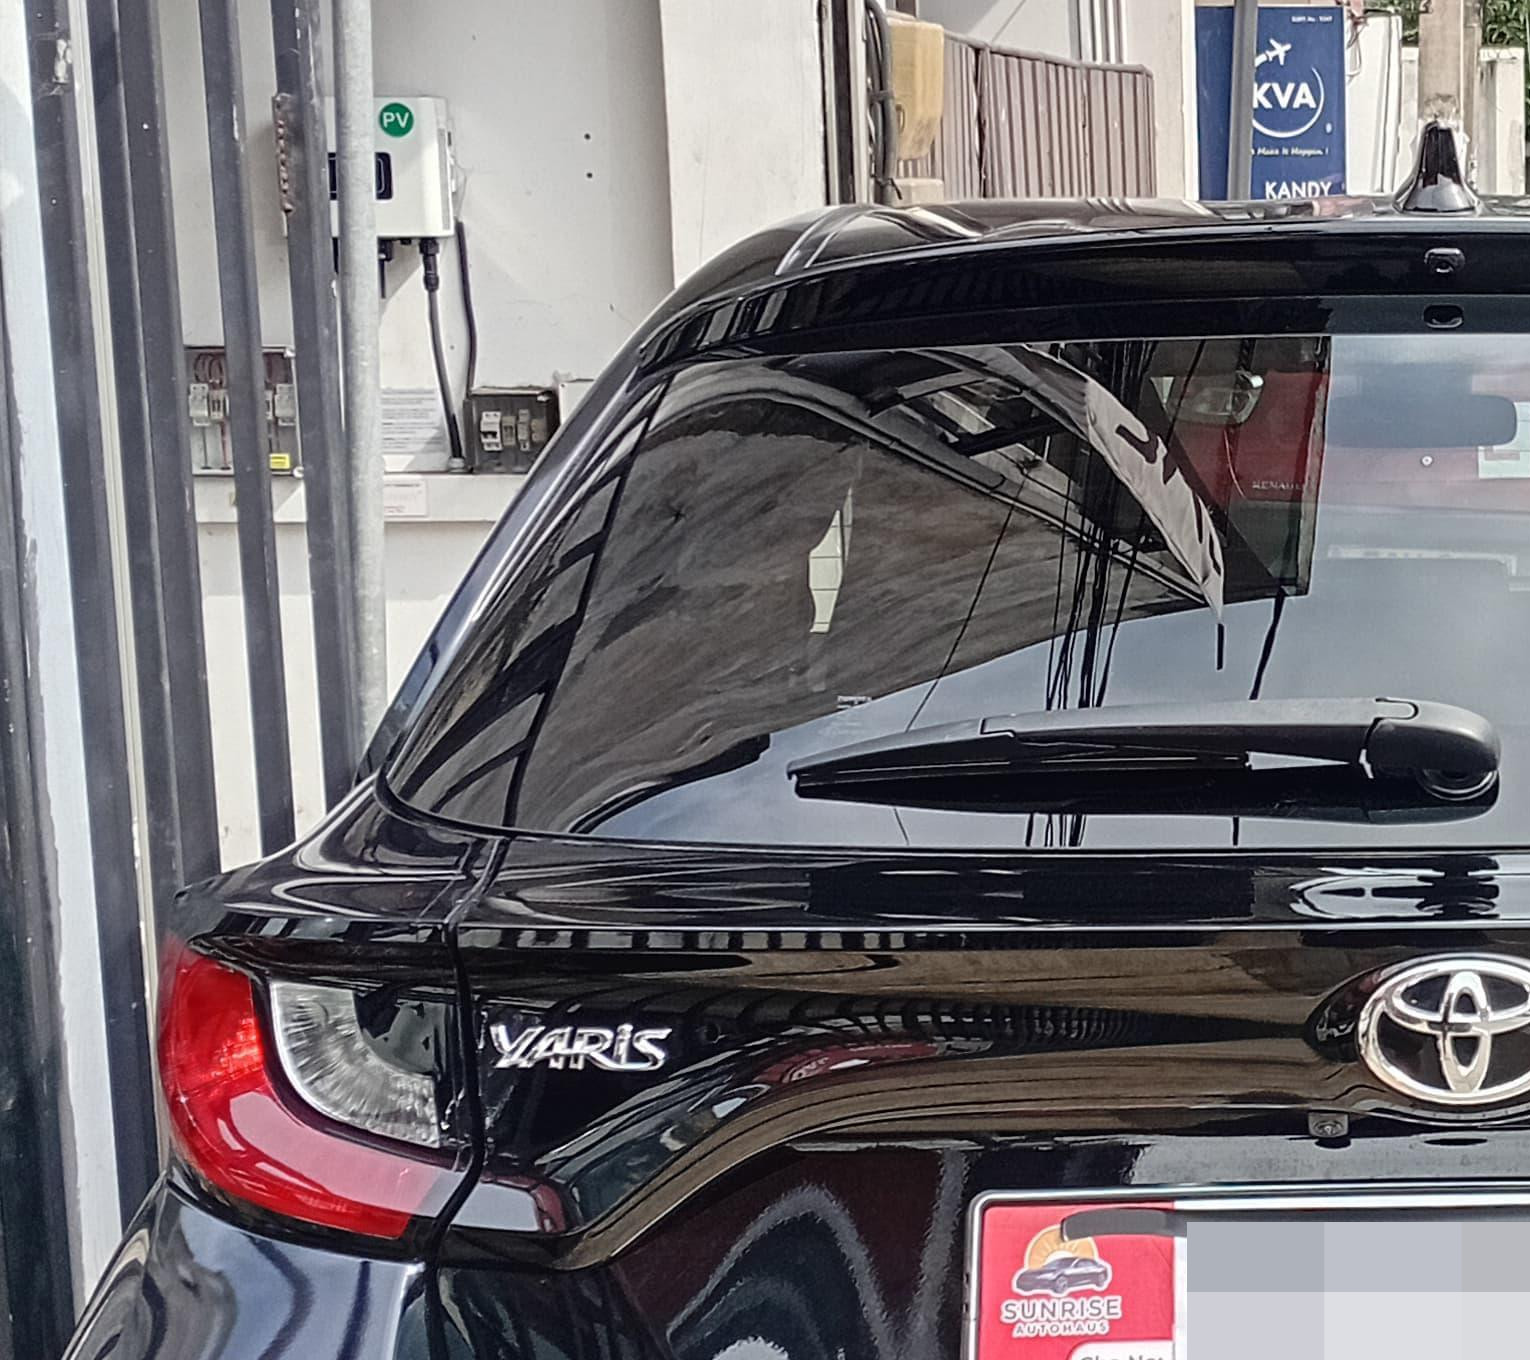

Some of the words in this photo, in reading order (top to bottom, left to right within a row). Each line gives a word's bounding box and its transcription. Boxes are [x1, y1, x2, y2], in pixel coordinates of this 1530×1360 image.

[1253, 82, 1317, 109] KVA
[383, 112, 410, 128] PV
[1265, 181, 1332, 200] KANDY
[1003, 1297, 1121, 1321] SUNRISE
[1015, 1321, 1108, 1336] AUTOHAUS
